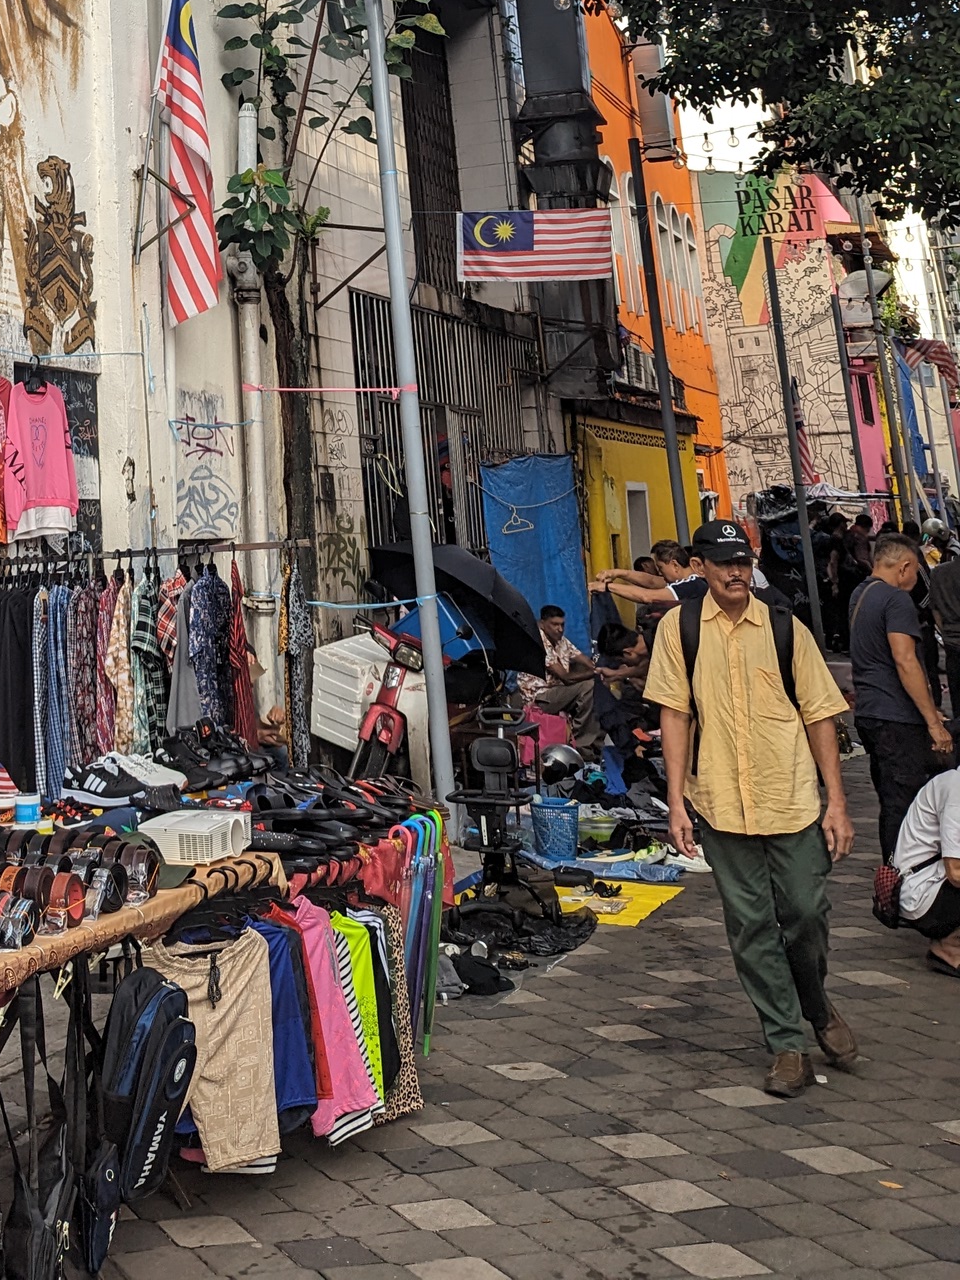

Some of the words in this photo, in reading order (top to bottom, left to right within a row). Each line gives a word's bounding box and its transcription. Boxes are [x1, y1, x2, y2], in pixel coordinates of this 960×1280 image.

[734, 185, 816, 216] PASAR
[738, 209, 817, 238] KARAT
[134, 1110, 168, 1190] YAMAHA
